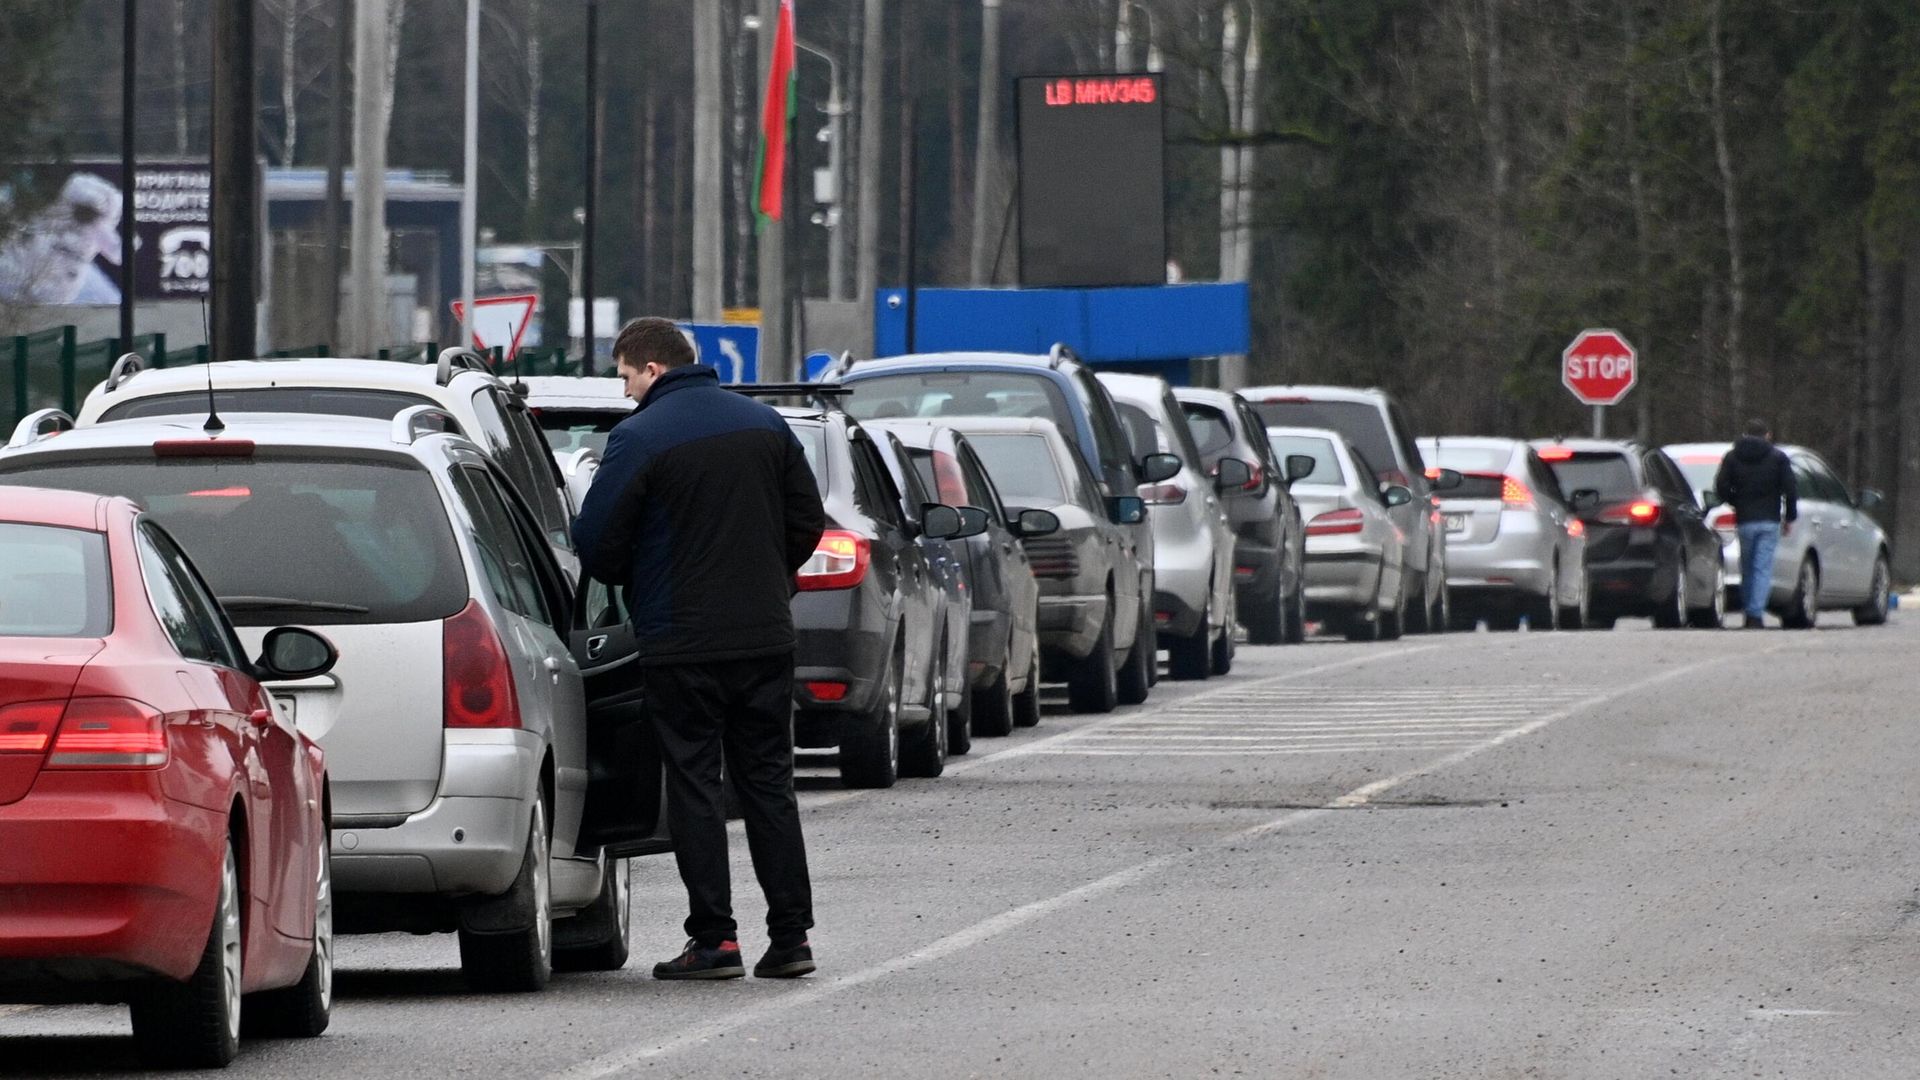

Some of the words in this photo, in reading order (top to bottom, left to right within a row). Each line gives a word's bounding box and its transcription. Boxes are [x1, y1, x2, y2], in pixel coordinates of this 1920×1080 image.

[1045, 80, 1073, 105] LB
[1075, 78, 1157, 104] MHV345
[1568, 354, 1630, 379] STOP
